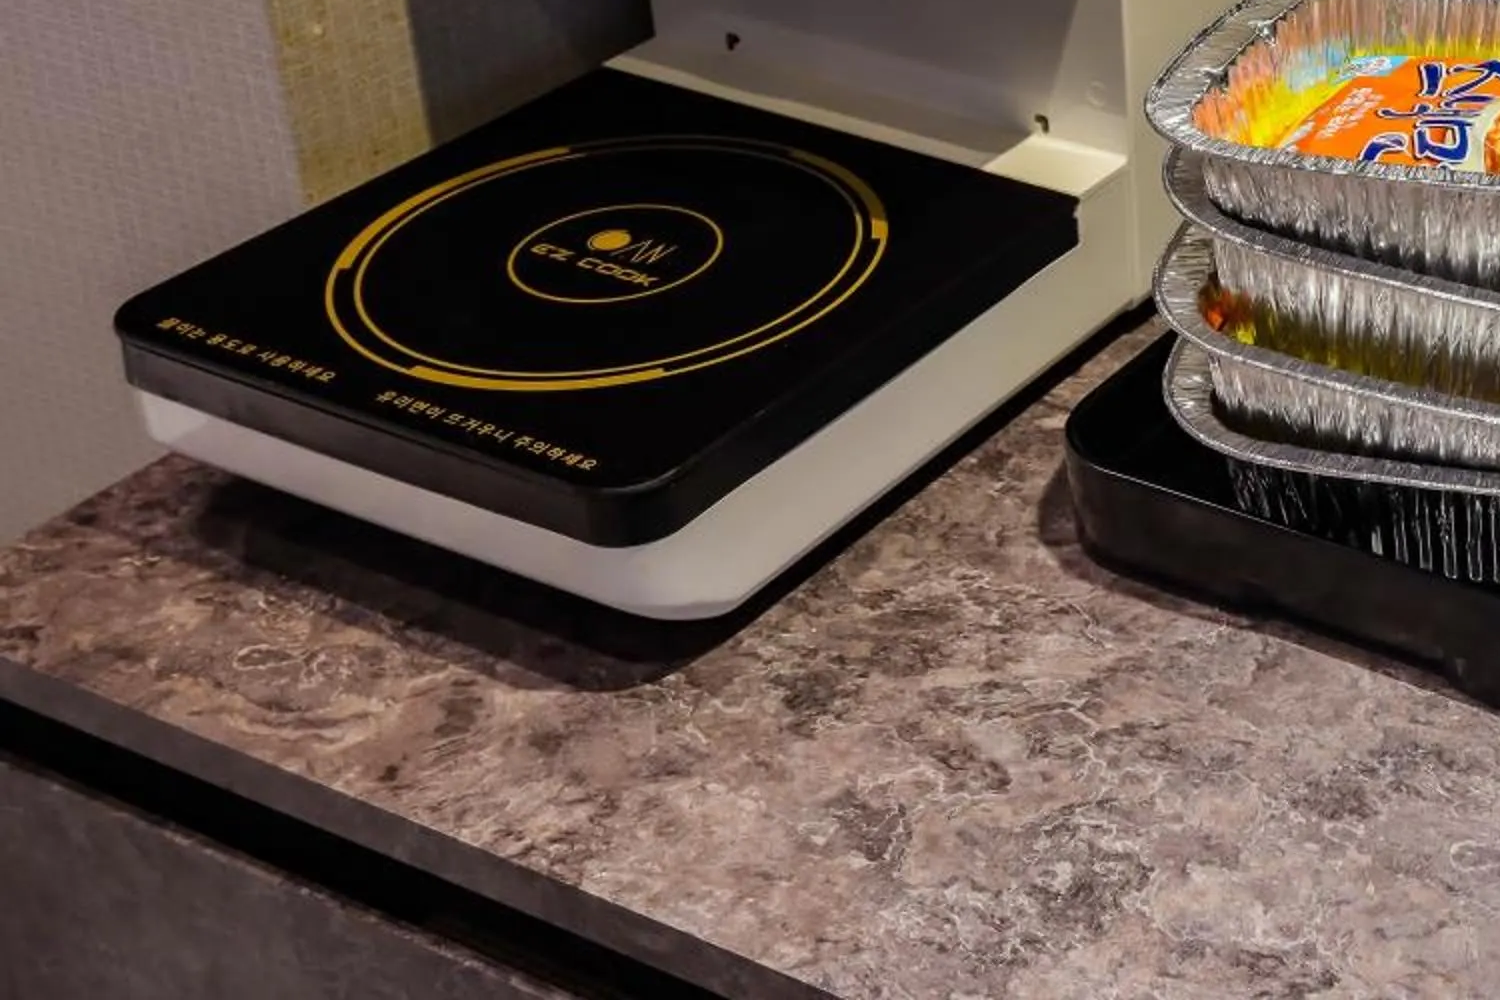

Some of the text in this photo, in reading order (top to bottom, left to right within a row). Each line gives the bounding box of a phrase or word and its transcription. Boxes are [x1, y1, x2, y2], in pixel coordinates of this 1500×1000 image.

[531, 243, 660, 287] EZ COOK
[256, 347, 337, 384] 사용하세요
[374, 390, 598, 471] 유리면이 뜨거우니 주의하세요
